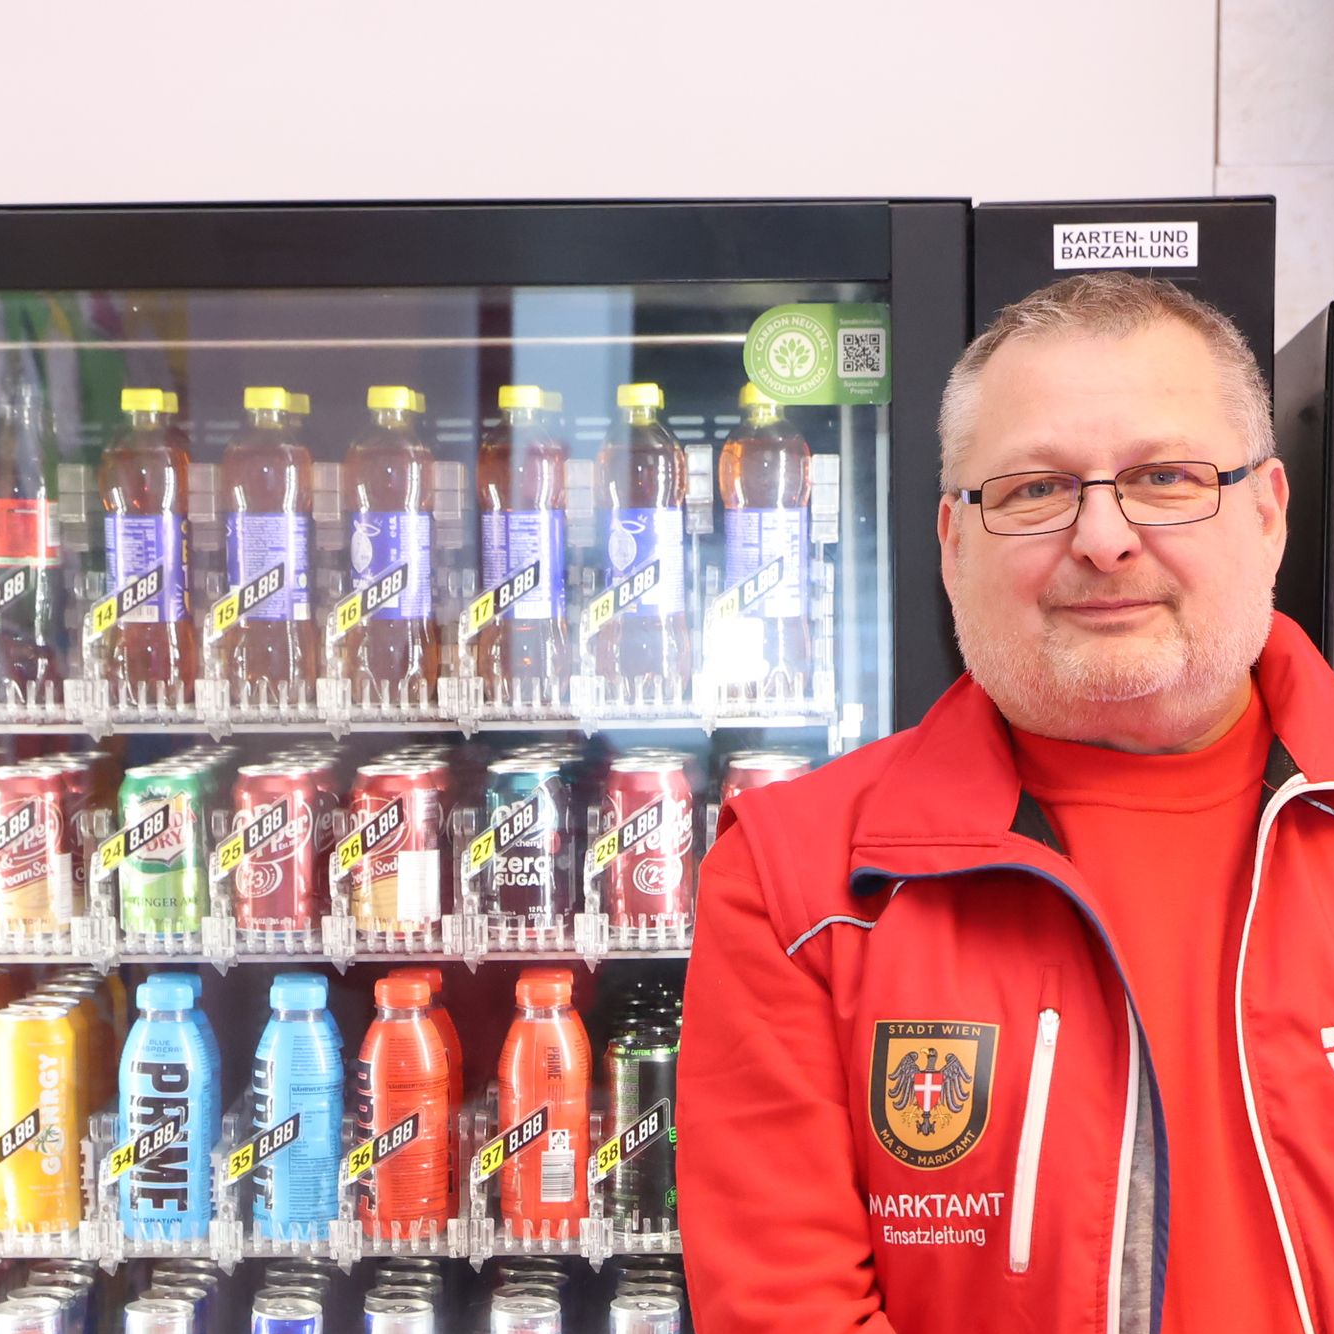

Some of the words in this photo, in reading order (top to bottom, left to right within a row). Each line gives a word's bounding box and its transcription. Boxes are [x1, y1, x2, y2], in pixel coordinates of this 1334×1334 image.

[1061, 244, 1189, 262] BARZAHLUNG
[1062, 230, 1145, 245] KARTEN-
[1150, 230, 1189, 243] UND
[755, 315, 790, 351] CARBON
[792, 315, 829, 351] NEUTRAL
[758, 366, 827, 395] SANDENVENDO
[843, 379, 879, 389] Sustainable
[850, 388, 874, 396] Project
[95, 603, 113, 626] 14
[122, 570, 158, 612] 8.88
[217, 602, 235, 626] 15
[243, 568, 279, 610] 8.88
[340, 602, 357, 626] 16
[366, 568, 402, 610] 8.88
[471, 600, 490, 623] 17
[499, 565, 535, 608] 8.88
[592, 597, 610, 621] 18
[619, 563, 655, 607] 8.88
[102, 843, 122, 867] 24
[129, 810, 165, 851] 8.88
[221, 841, 242, 867] 25
[248, 807, 284, 848] 8.88
[339, 842, 360, 866] 26
[366, 807, 400, 849] 8.88
[472, 837, 493, 863] 27
[499, 806, 534, 848] 8.88
[515, 838, 544, 850] cherry
[596, 837, 617, 863] 28
[623, 805, 659, 848] 8.88
[495, 855, 551, 874] zero
[495, 871, 551, 887] SUGAR
[888, 1024, 935, 1035] STADT
[942, 1024, 982, 1037] WIEN
[547, 1046, 563, 1081] PRIME
[1, 1113, 35, 1157] 8.88
[111, 1149, 132, 1175] 34
[138, 1120, 175, 1159] 8.88
[230, 1149, 250, 1175] 35
[258, 1118, 295, 1158] 8.88
[350, 1148, 371, 1174] 36
[378, 1118, 414, 1158] 8.88
[481, 1145, 502, 1172] 37
[509, 1113, 543, 1153] 8.88
[598, 1143, 618, 1170] 38
[625, 1111, 659, 1153] 8.88
[879, 1128, 894, 1148] MA
[895, 1145, 909, 1159] 59
[917, 1129, 976, 1166] MARKTAMT
[868, 1192, 1005, 1218] MARKTAMT
[883, 1225, 986, 1247] Einsatzleitung
